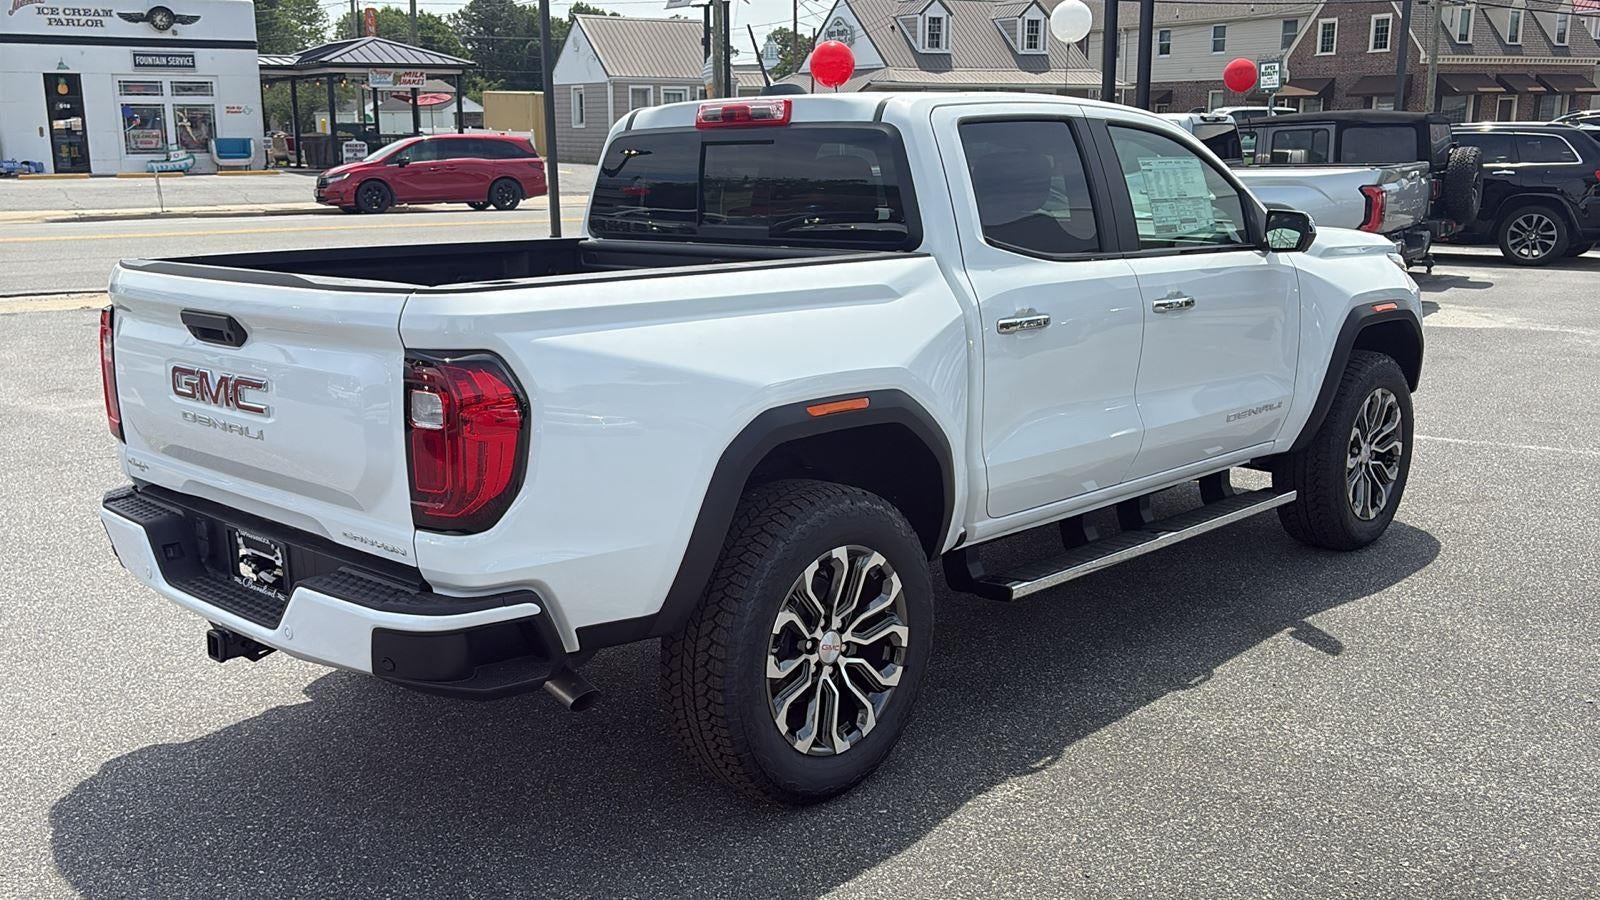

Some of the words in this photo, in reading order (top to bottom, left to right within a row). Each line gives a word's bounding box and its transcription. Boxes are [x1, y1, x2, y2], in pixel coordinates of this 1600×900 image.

[36, 6, 60, 16] ICE
[62, 7, 114, 17] CREAM
[47, 17, 104, 28] PARLOR
[135, 55, 167, 65] FOUNTAIN
[167, 56, 194, 66] SERVICE
[171, 364, 271, 418] GMC
[1225, 401, 1283, 423] DENALI
[181, 410, 265, 441] DENALI
[821, 644, 840, 652] GMC
